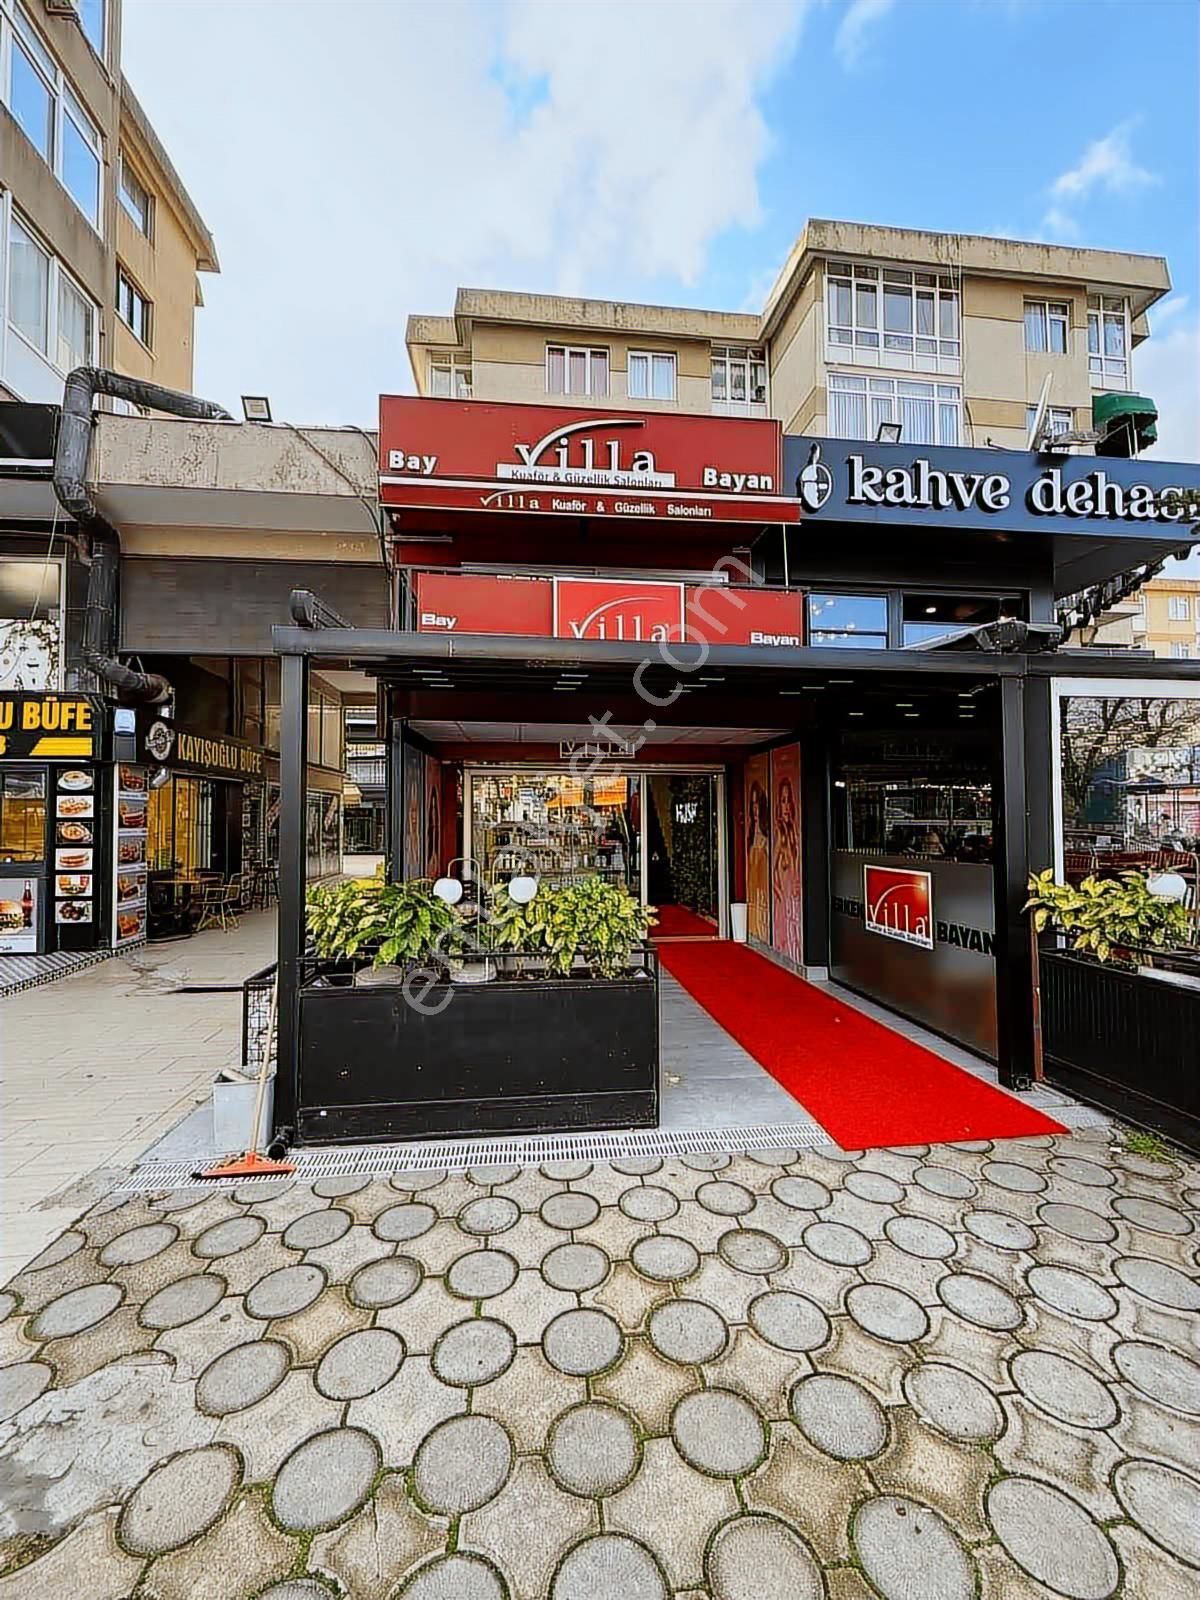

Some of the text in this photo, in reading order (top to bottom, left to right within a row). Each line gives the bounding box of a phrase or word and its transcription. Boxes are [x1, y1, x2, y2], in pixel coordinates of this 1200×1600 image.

[388, 450, 437, 475] Bay
[511, 469, 549, 483] Kuaför
[553, 472, 561, 482] &
[564, 472, 610, 485] Güzellik
[703, 468, 773, 493] Bayan
[849, 455, 1010, 510] kahve
[552, 498, 587, 512] Kuaför
[596, 501, 605, 512] &
[615, 501, 656, 516] Güzellik
[667, 504, 712, 518] Salonları
[422, 613, 456, 630] Bay
[750, 632, 799, 647] Bayan
[22, 697, 92, 730] BÜFE
[178, 733, 238, 769] KAYIŞOĞLU
[240, 747, 262, 774] BÜFE
[937, 921, 996, 955] BAYAN
